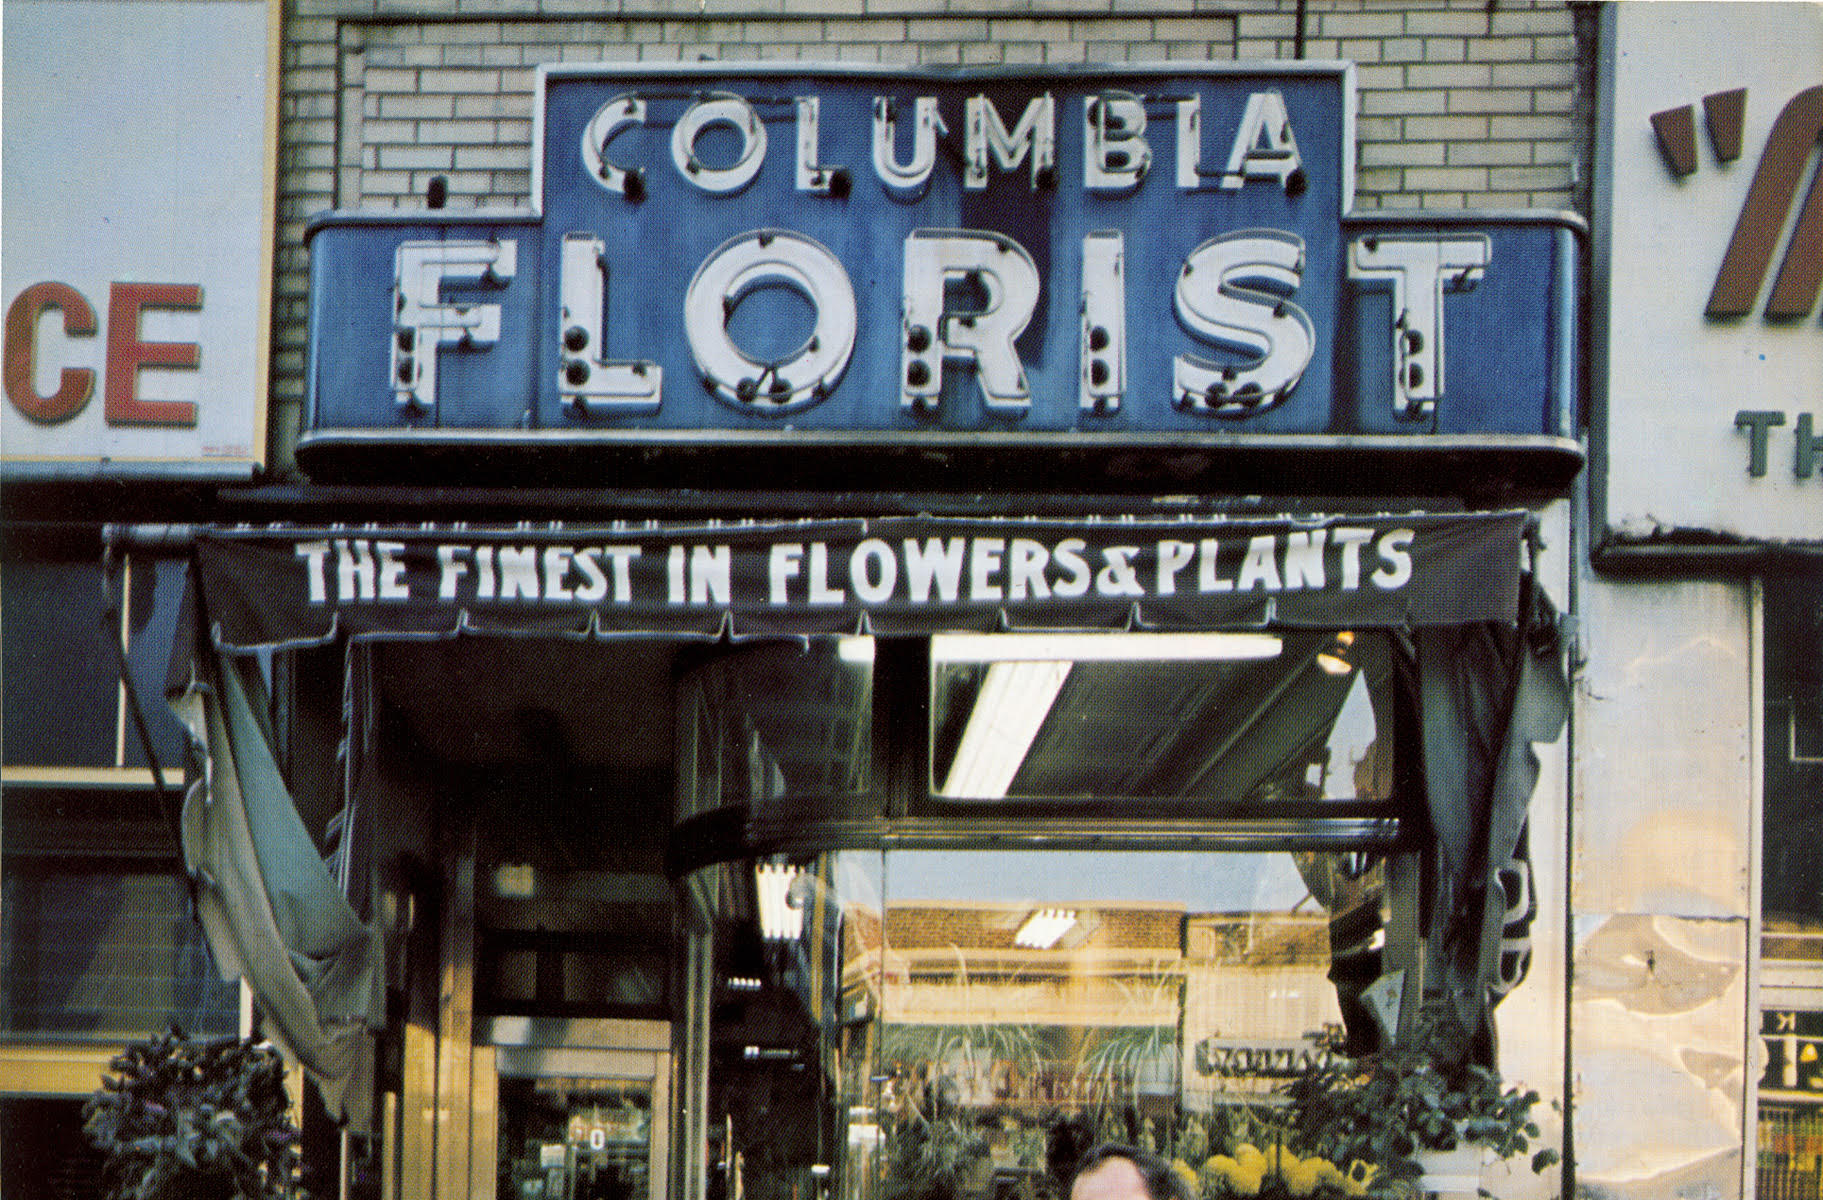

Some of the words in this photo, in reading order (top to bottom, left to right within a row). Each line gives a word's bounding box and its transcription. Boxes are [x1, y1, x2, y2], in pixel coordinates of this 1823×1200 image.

[580, 90, 1304, 194] COLUMBIA
[3, 280, 204, 428] CE
[388, 228, 1493, 418] FLORIST
[295, 541, 410, 604] THE
[438, 542, 643, 604] FINEST
[666, 544, 733, 604] IN
[767, 535, 1087, 607] FLOWERS
[1094, 548, 1144, 600] &
[1154, 527, 1416, 600] PLANTS
